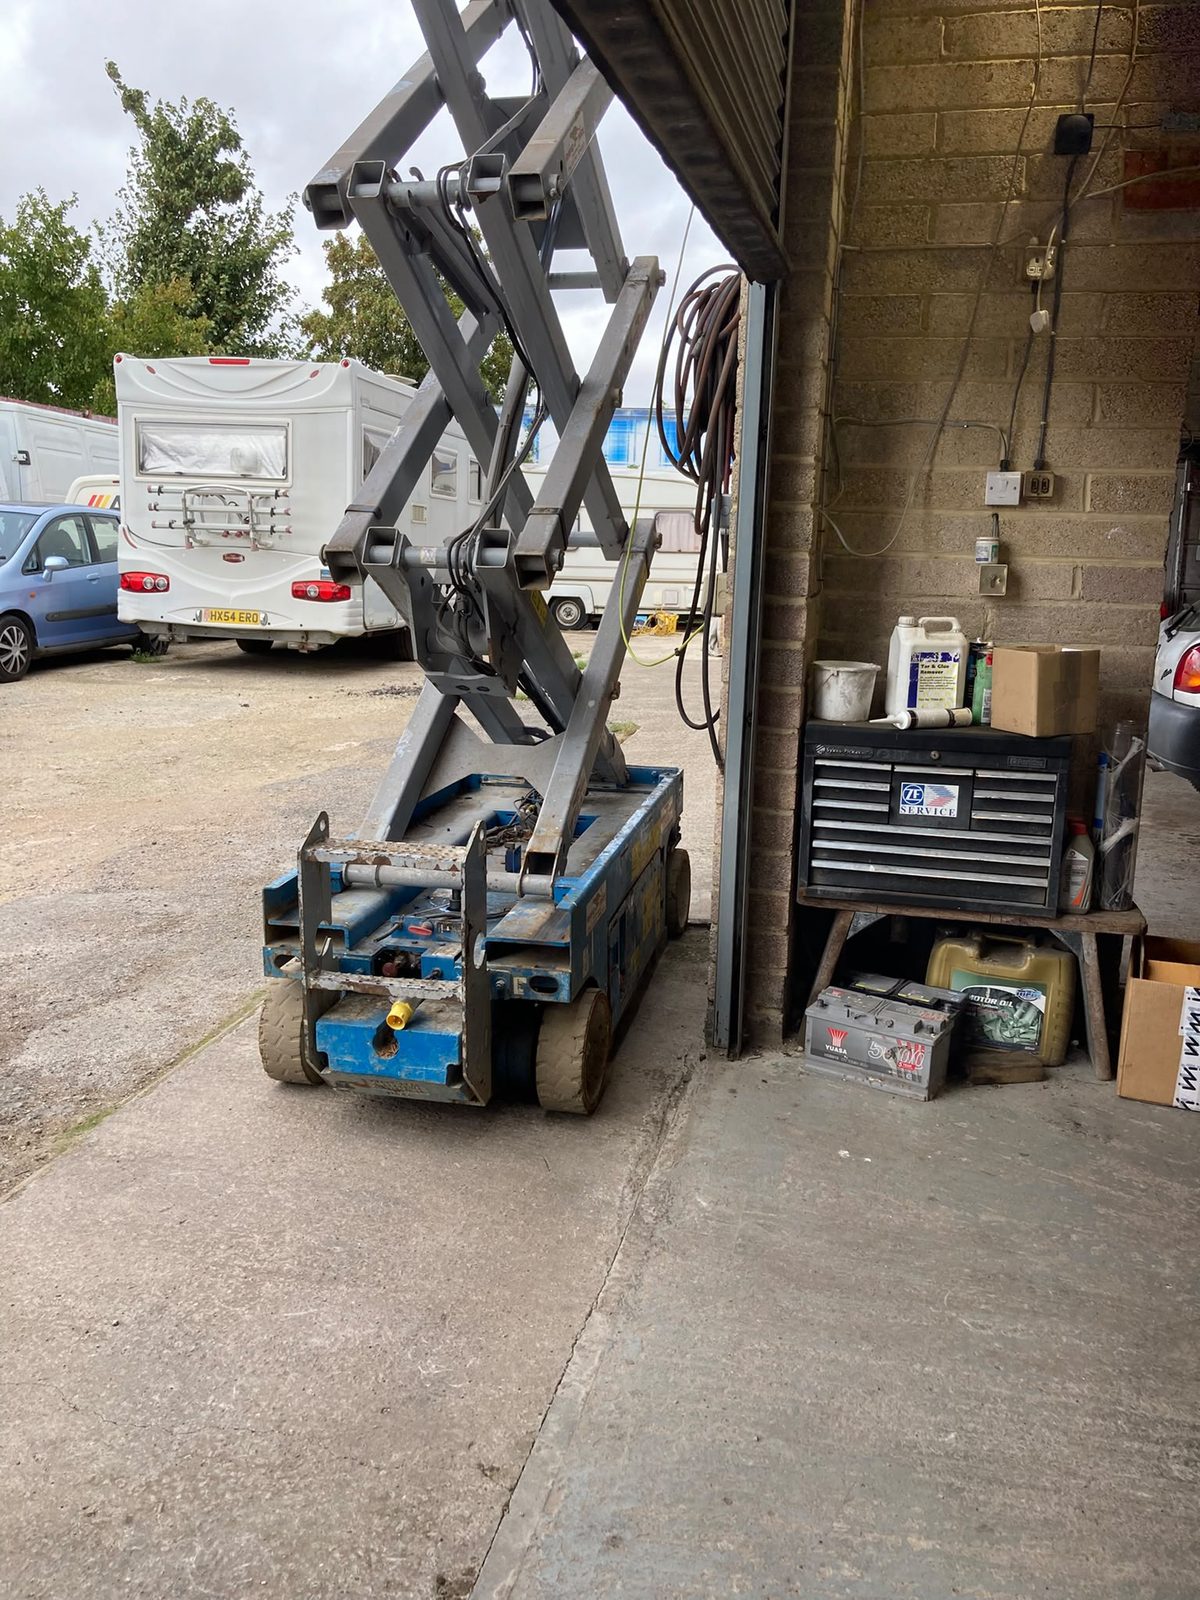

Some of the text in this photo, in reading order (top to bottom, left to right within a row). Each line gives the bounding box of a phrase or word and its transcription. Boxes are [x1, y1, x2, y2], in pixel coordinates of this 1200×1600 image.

[210, 610, 236, 622] HX54
[904, 788, 921, 802] ZF
[900, 805, 957, 818] SERVICE
[969, 994, 998, 1006] MOTOR
[999, 1000, 1014, 1009] OIL
[825, 1043, 848, 1056] YUASA
